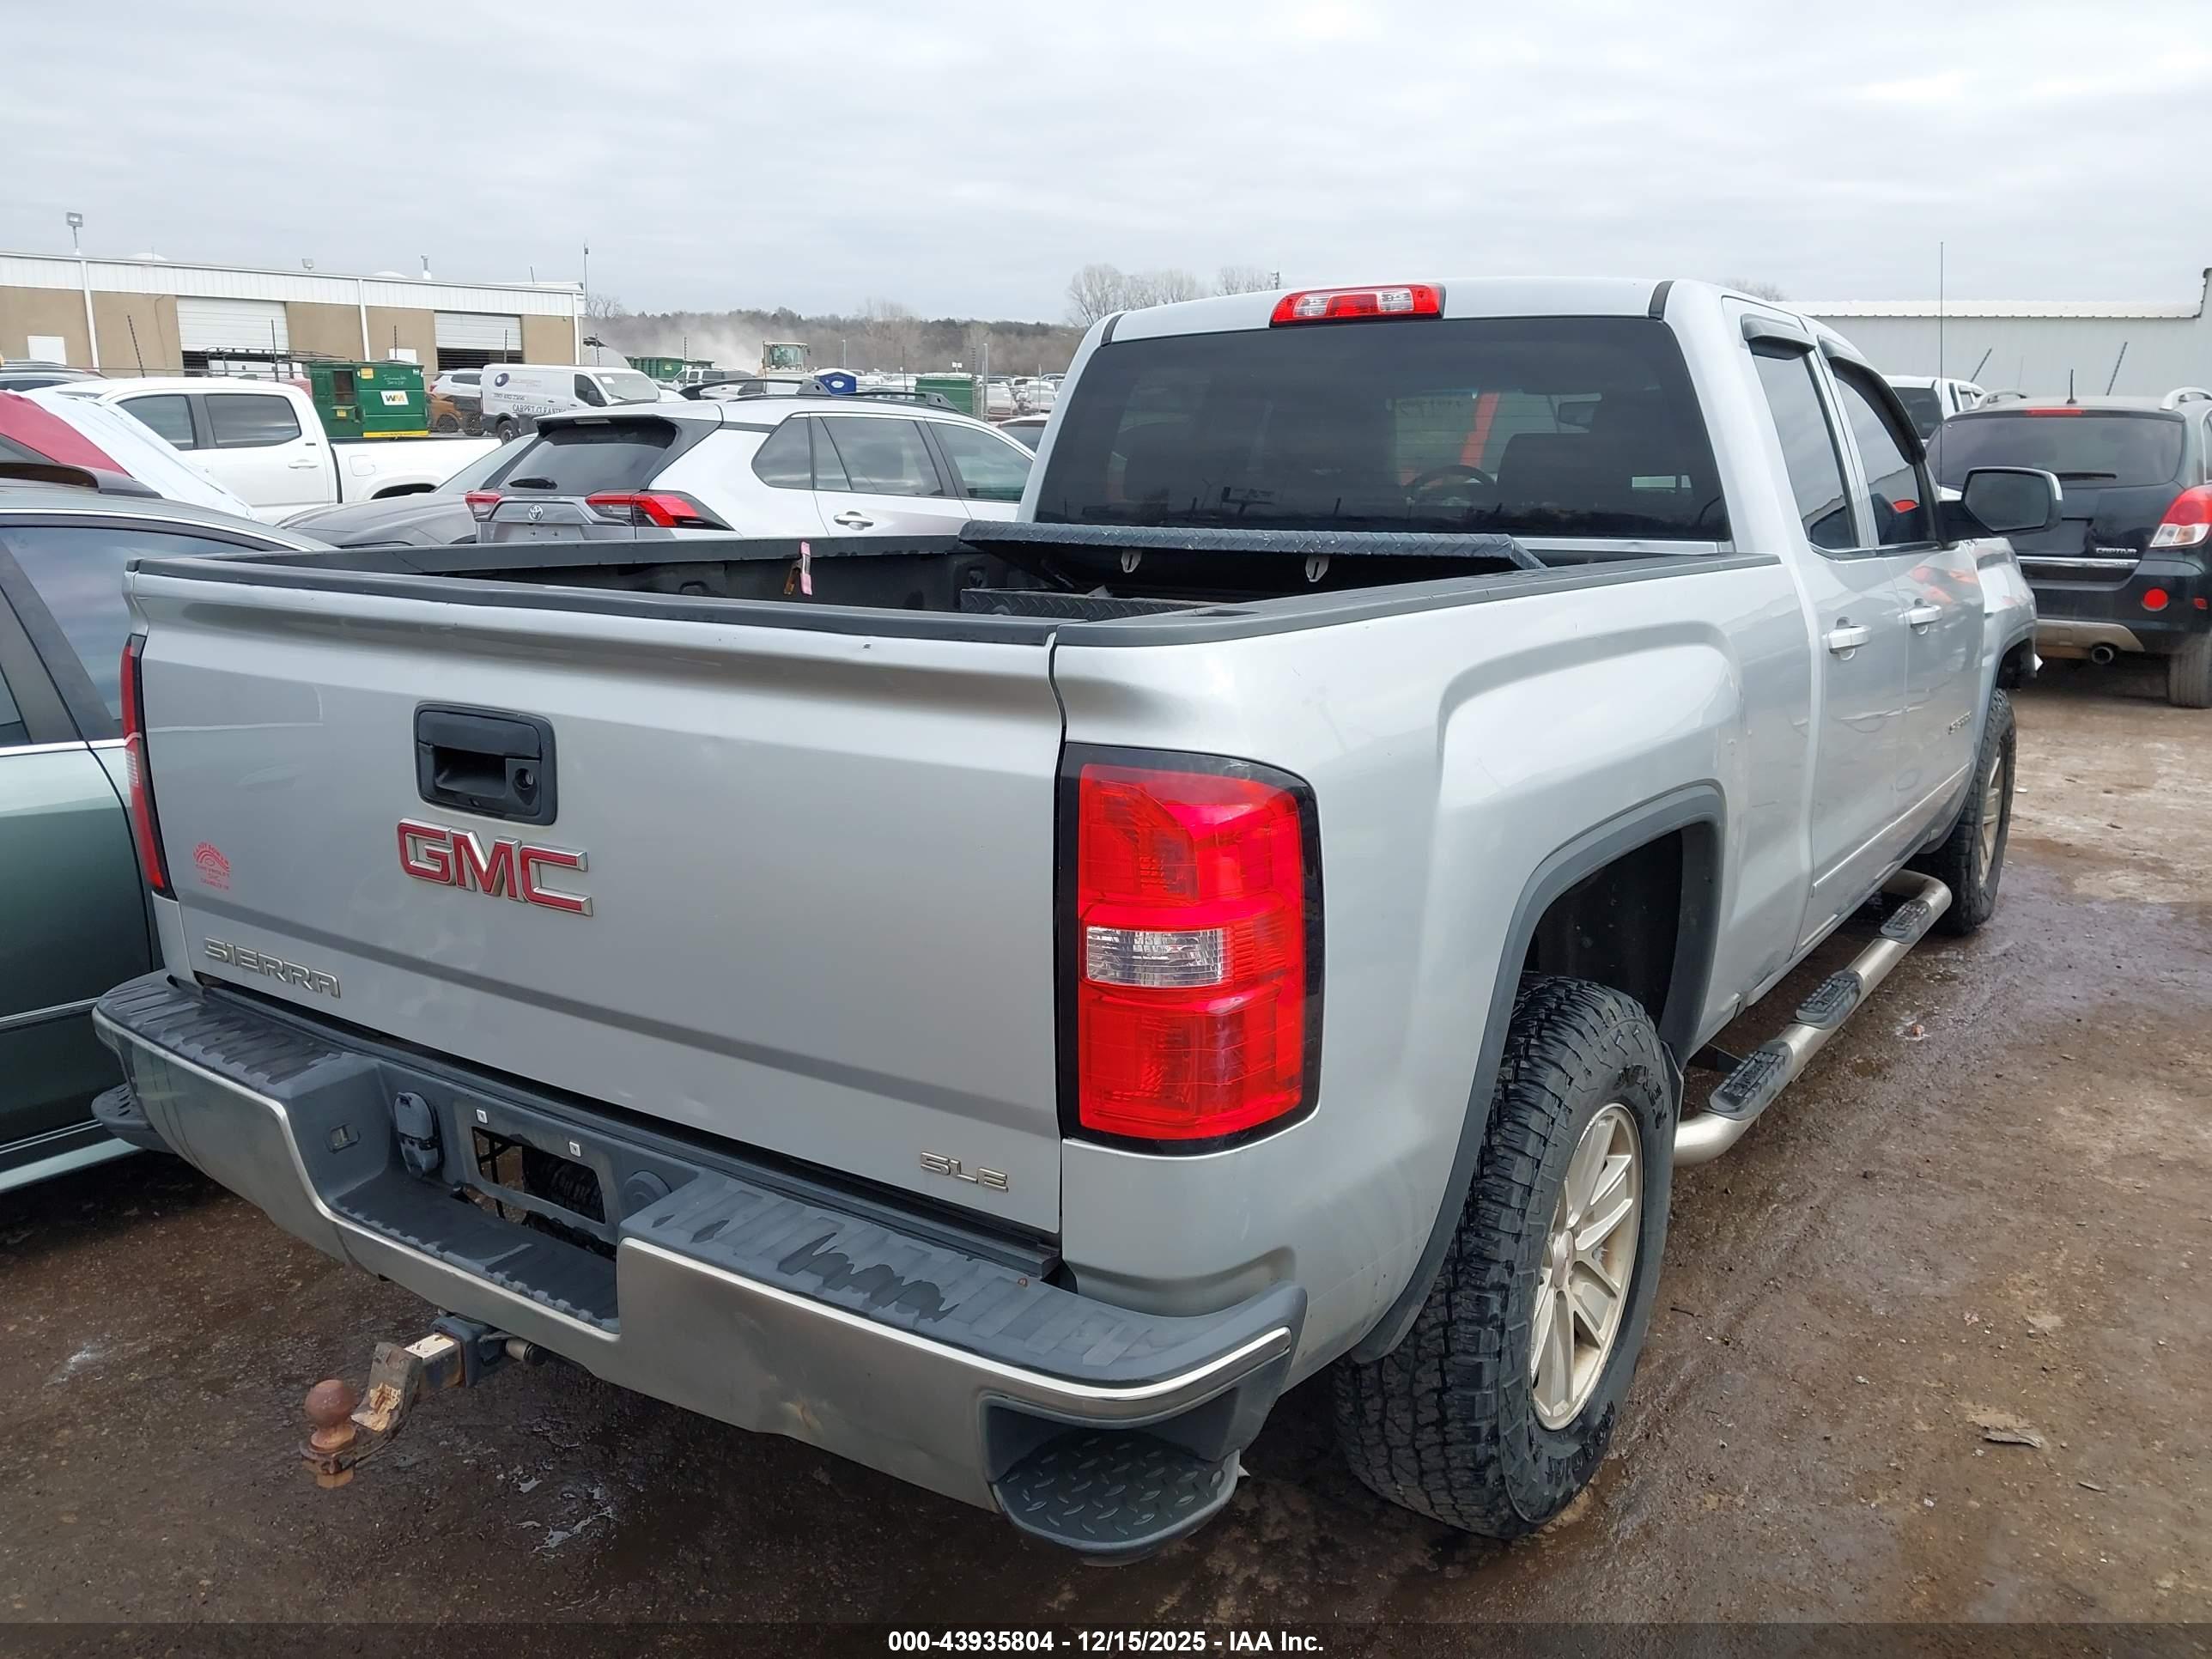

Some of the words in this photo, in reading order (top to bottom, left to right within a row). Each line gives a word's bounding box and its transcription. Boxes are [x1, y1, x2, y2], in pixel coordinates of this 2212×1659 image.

[398, 817, 592, 916] GMC
[205, 937, 341, 999] SIERRA
[921, 1152, 1009, 1193] SLE
